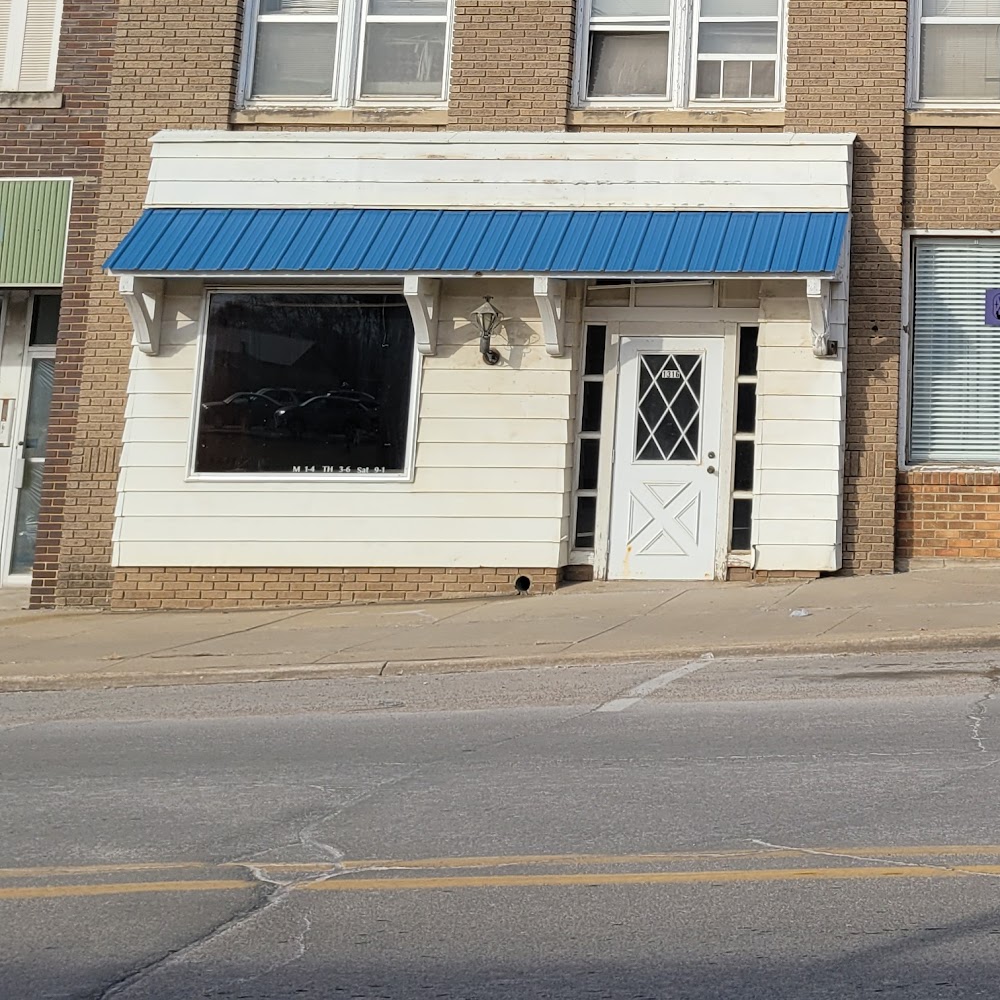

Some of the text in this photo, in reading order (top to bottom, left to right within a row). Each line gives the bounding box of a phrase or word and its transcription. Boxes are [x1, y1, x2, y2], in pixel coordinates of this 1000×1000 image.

[662, 370, 680, 378] 1316
[292, 465, 301, 473] M
[304, 465, 316, 473] 1-4
[322, 465, 334, 473] TH
[338, 465, 351, 473] 3-6
[356, 466, 370, 474] Sat
